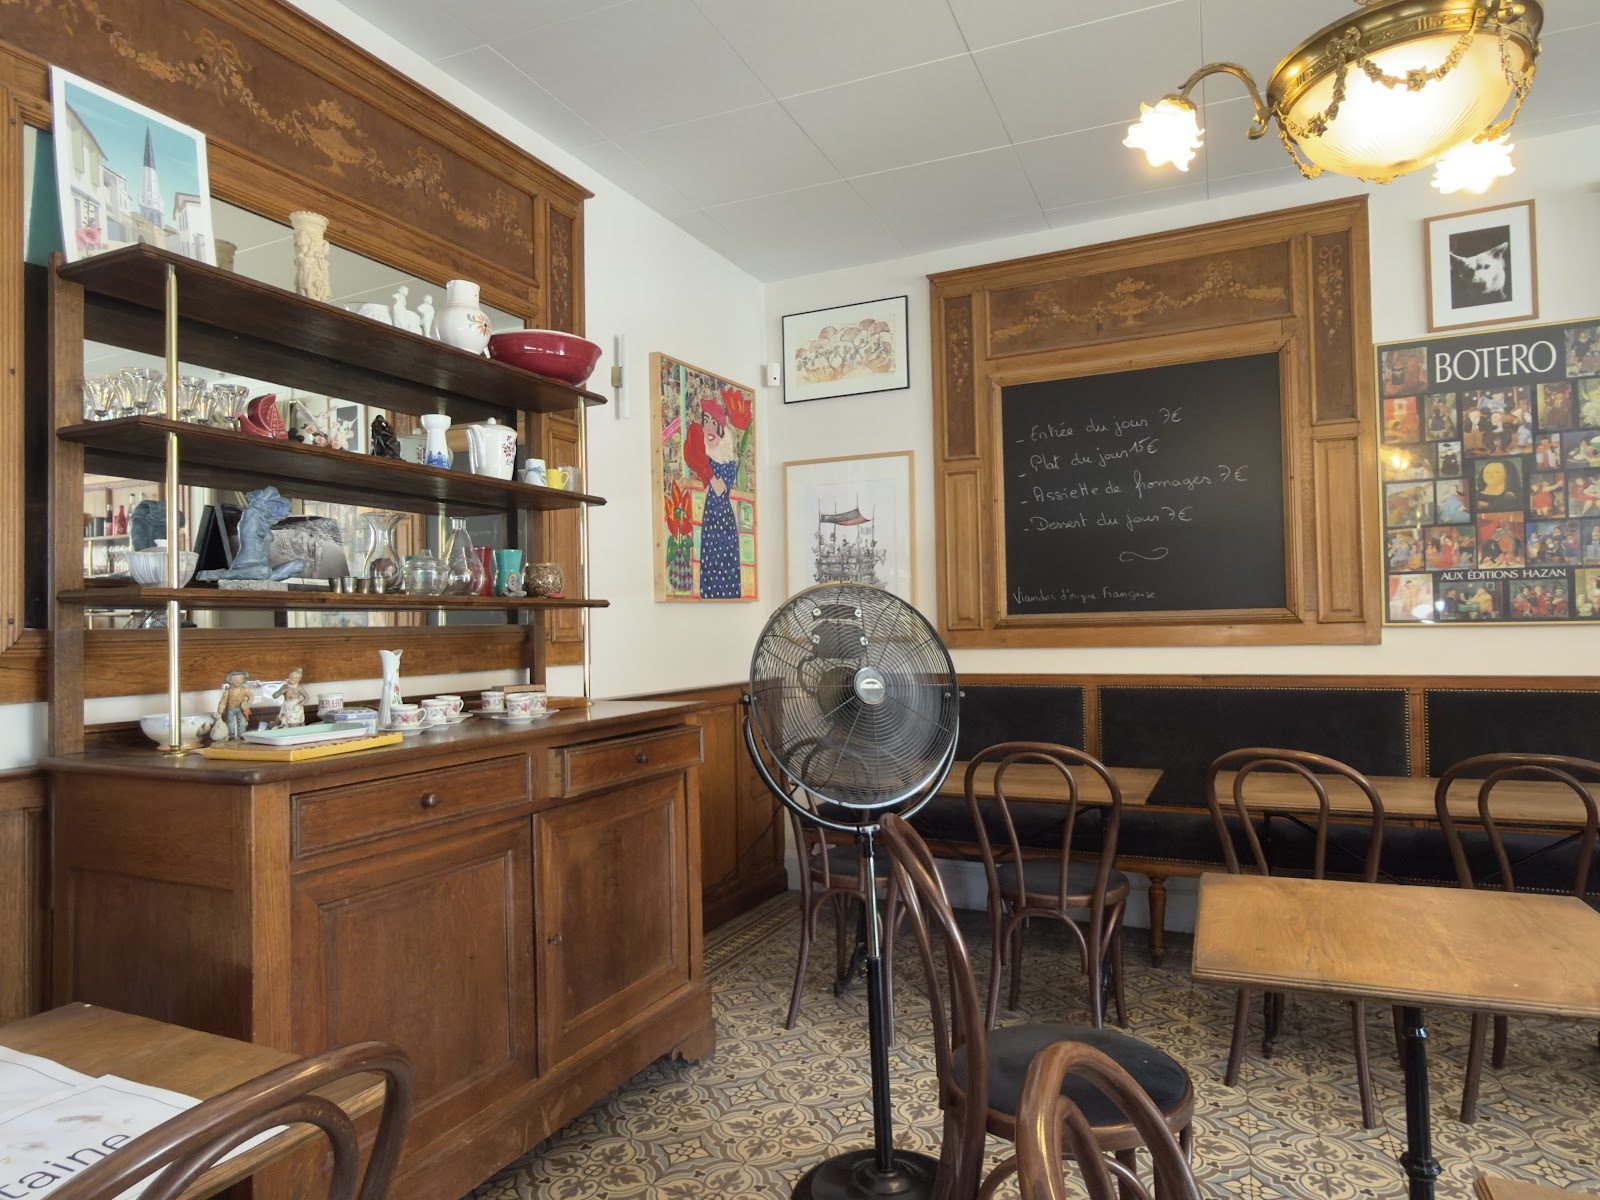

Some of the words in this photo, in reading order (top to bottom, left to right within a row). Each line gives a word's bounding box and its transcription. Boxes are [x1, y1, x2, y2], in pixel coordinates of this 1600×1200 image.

[1435, 340, 1557, 383] BOTERO
[1031, 422, 1074, 442] Entrée
[1086, 417, 1108, 433] du
[1114, 415, 1148, 436] jour
[1030, 454, 1060, 472] Plat
[1071, 452, 1092, 466] du
[1096, 447, 1128, 467] jour
[1033, 480, 1098, 502] Assiette
[1105, 480, 1122, 494] de
[1132, 470, 1211, 499] fromages
[1030, 512, 1088, 531] Dessert
[1096, 511, 1119, 526] du
[1127, 510, 1159, 531] jour
[1440, 570, 1463, 581] AUX
[1523, 568, 1567, 578] HAZAN
